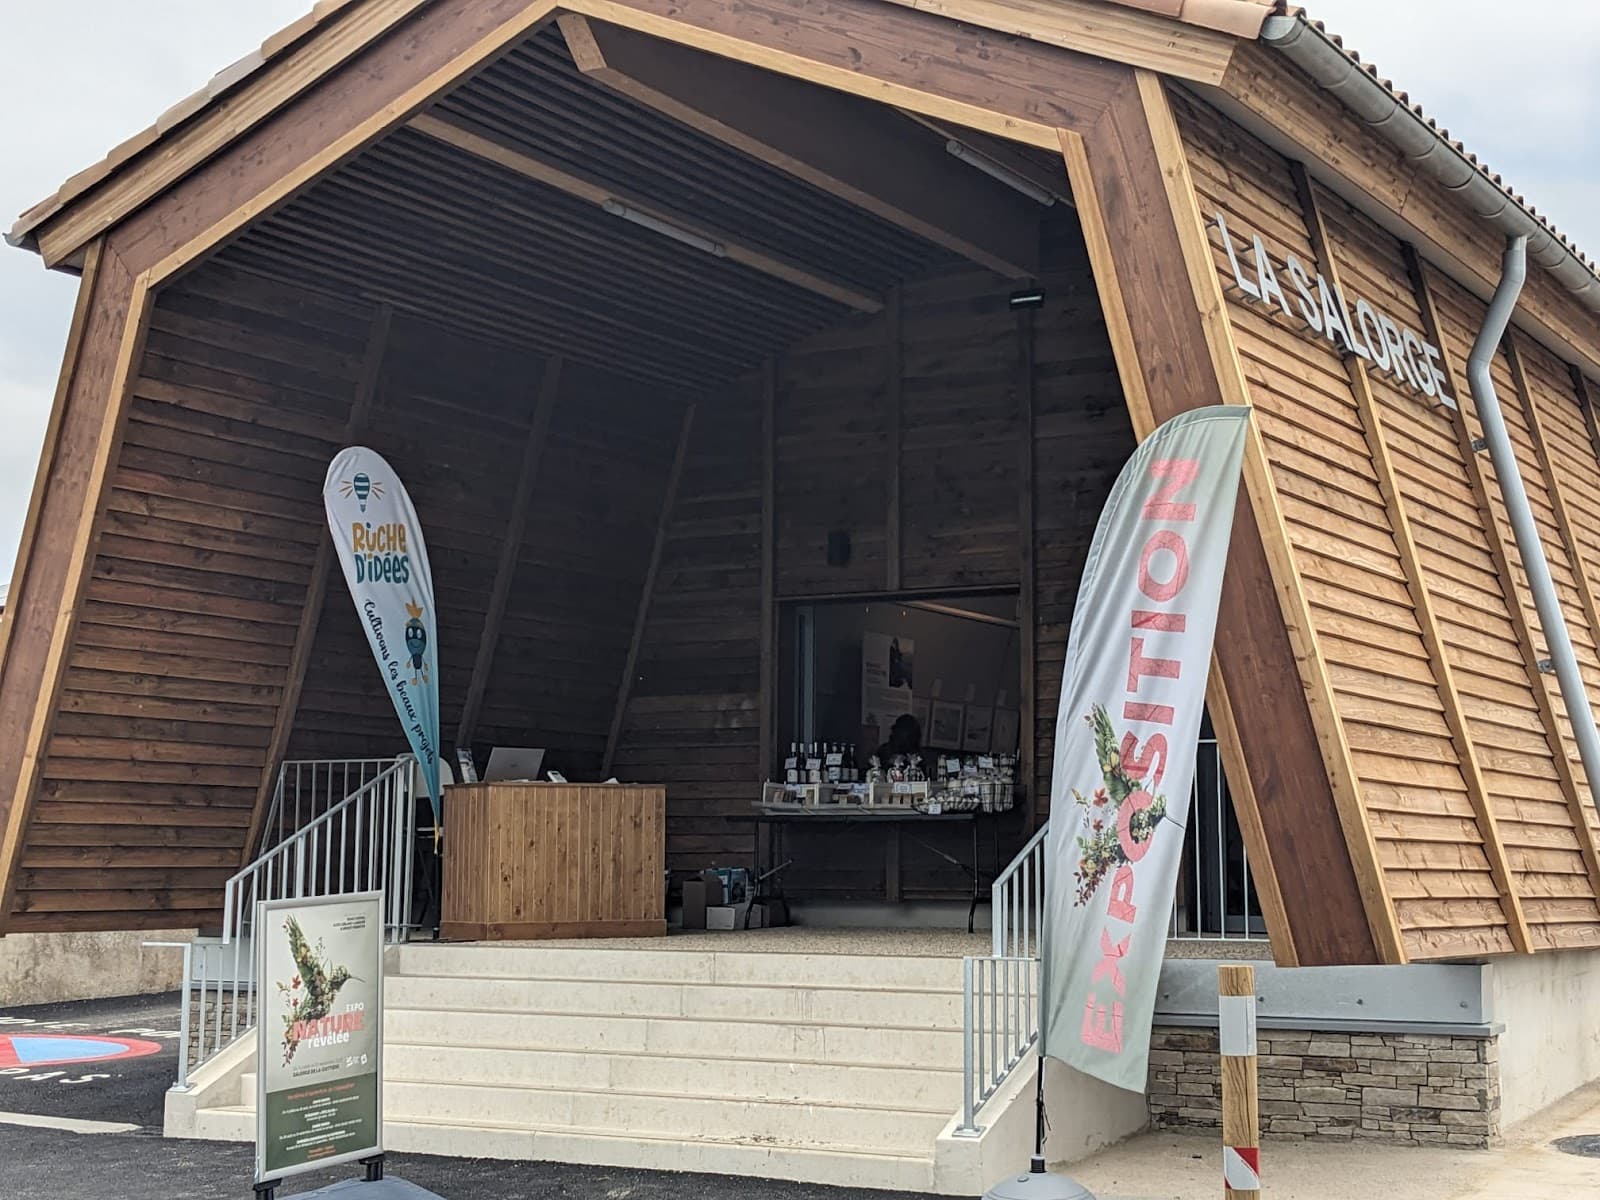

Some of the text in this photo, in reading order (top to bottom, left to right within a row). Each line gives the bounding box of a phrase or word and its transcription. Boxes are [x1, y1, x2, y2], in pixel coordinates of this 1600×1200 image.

[1215, 212, 1458, 411] LA SALORGE
[362, 598, 390, 661] Cultivons
[387, 660, 399, 681] les
[395, 679, 417, 722] beaux
[1080, 457, 1200, 1054] EXPOSITION
[293, 1010, 365, 1041] NATURE
[346, 1002, 364, 1012] EXPO
